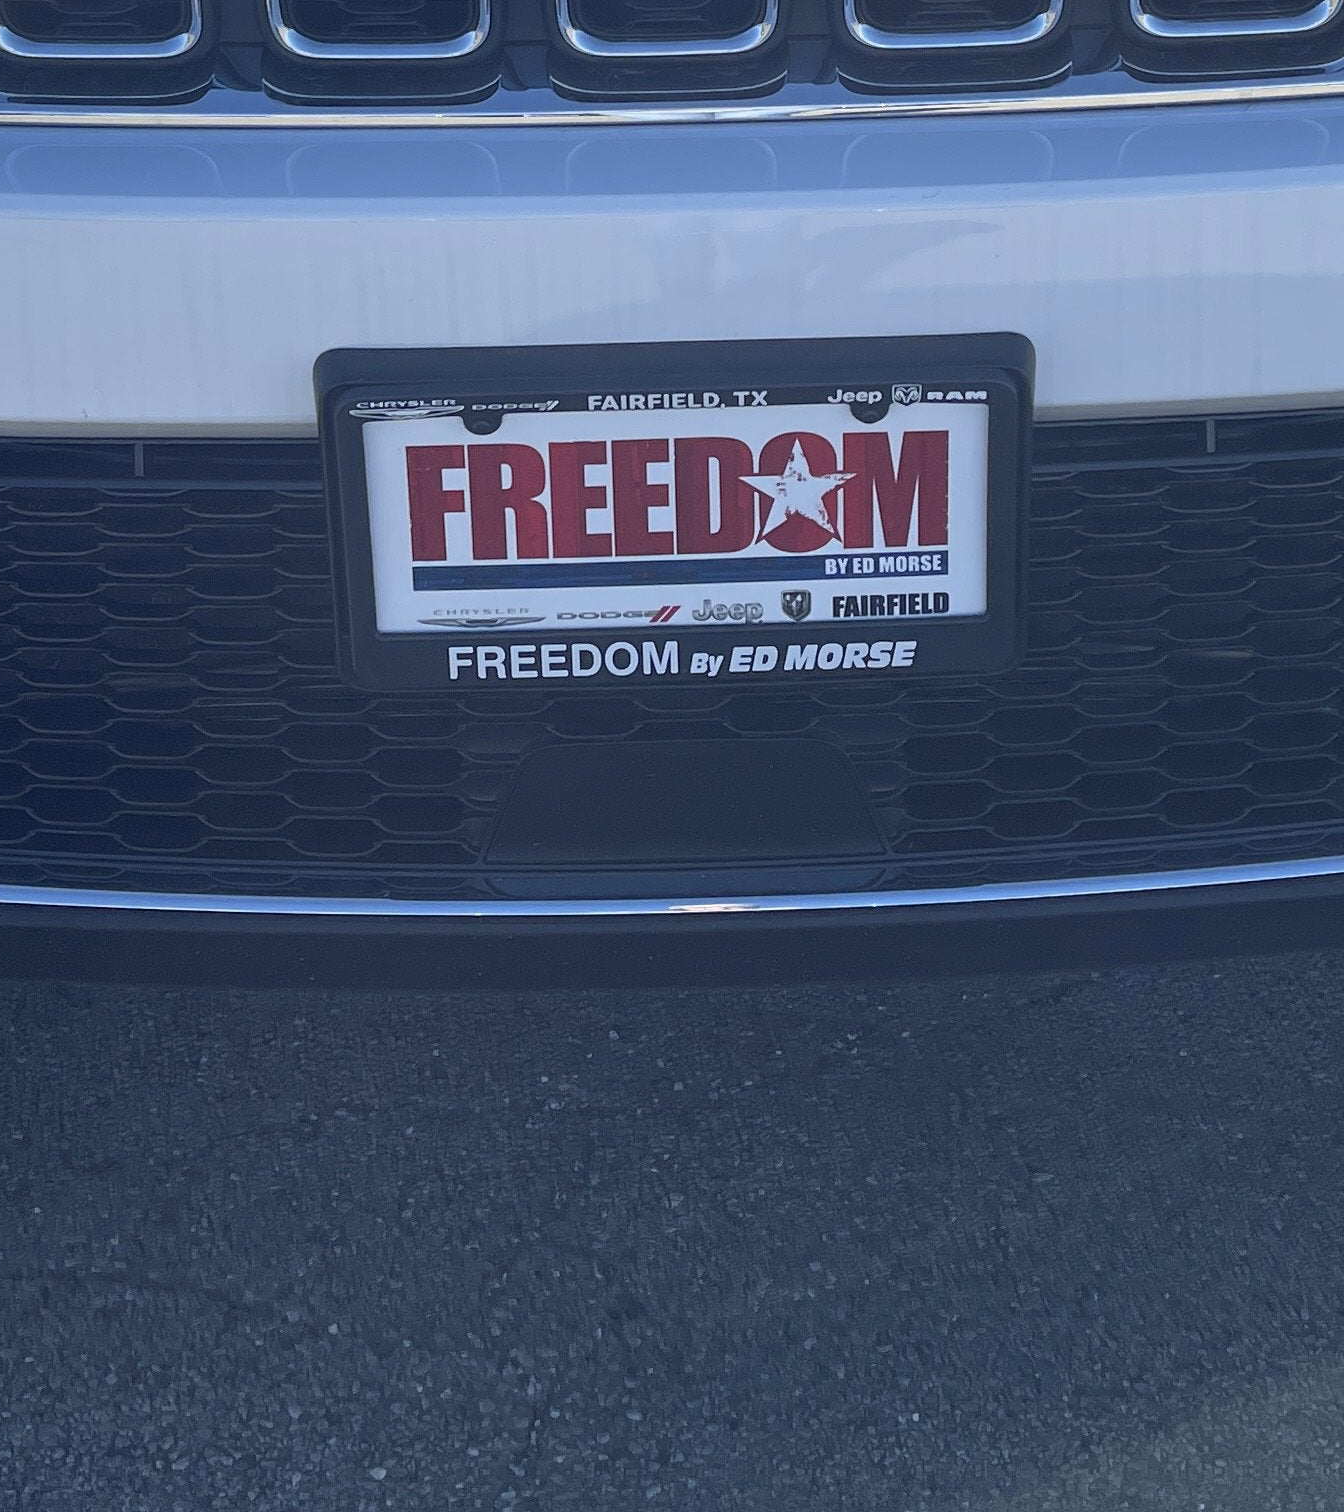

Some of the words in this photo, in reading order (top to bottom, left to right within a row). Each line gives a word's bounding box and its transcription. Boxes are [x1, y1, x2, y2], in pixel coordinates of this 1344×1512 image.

[733, 390, 768, 407] TX
[827, 389, 883, 404] Jeep
[926, 390, 988, 401] RAM
[356, 399, 457, 409] CHRYSLER
[471, 402, 547, 411] DODGE
[404, 430, 950, 562] FREEDOM
[825, 558, 849, 575] BY
[852, 556, 875, 574] ED
[879, 554, 942, 573] MORSE
[433, 607, 531, 617] CHRYSLER
[692, 599, 763, 624] Jeep
[832, 592, 950, 618] FAIRFIELD
[556, 609, 657, 620] DODGE
[448, 641, 680, 680] FREEDOM
[690, 651, 724, 677] By
[728, 645, 778, 673] ED
[783, 640, 918, 671] MORSE
